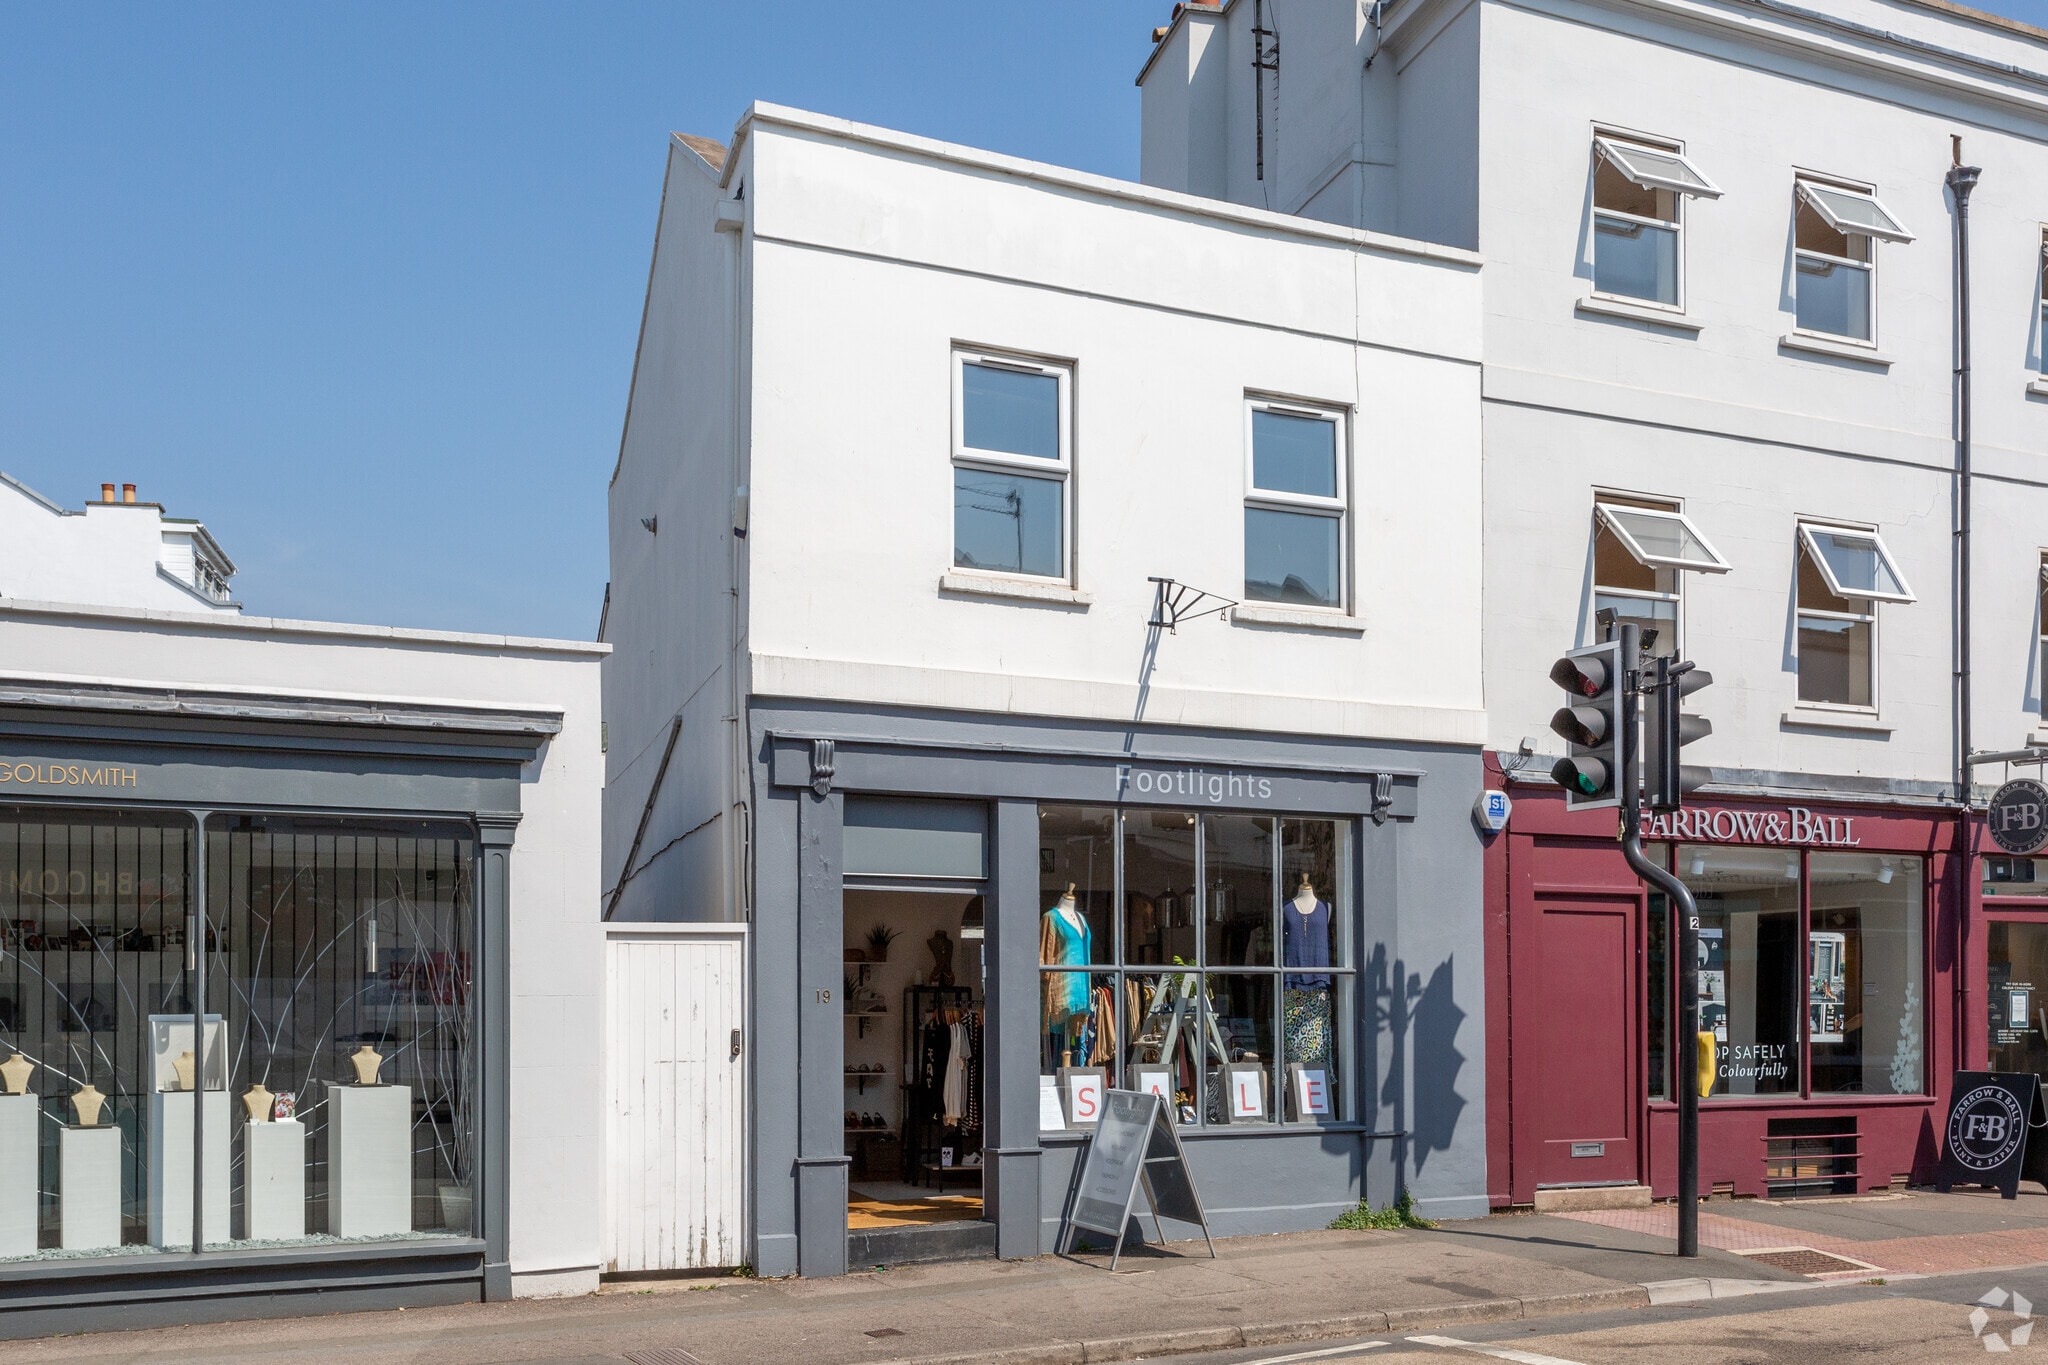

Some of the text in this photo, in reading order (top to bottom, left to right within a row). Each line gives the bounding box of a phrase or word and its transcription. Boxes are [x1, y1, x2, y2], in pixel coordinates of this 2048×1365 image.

[0, 762, 137, 787] GOLDSMITH
[1115, 764, 1272, 802] Footlights
[2000, 803, 2041, 832] F&B
[1691, 917, 1699, 929] 2
[816, 989, 831, 1004] 19
[1735, 1044, 1786, 1060] SAFELY
[1719, 1063, 1788, 1081] Colourfully
[1954, 1088, 2021, 1124] FARROW & BALL
[1964, 1114, 2006, 1142] F&B
[1952, 1134, 1972, 1163] PAINT
[1988, 1140, 2016, 1166] PAPER
